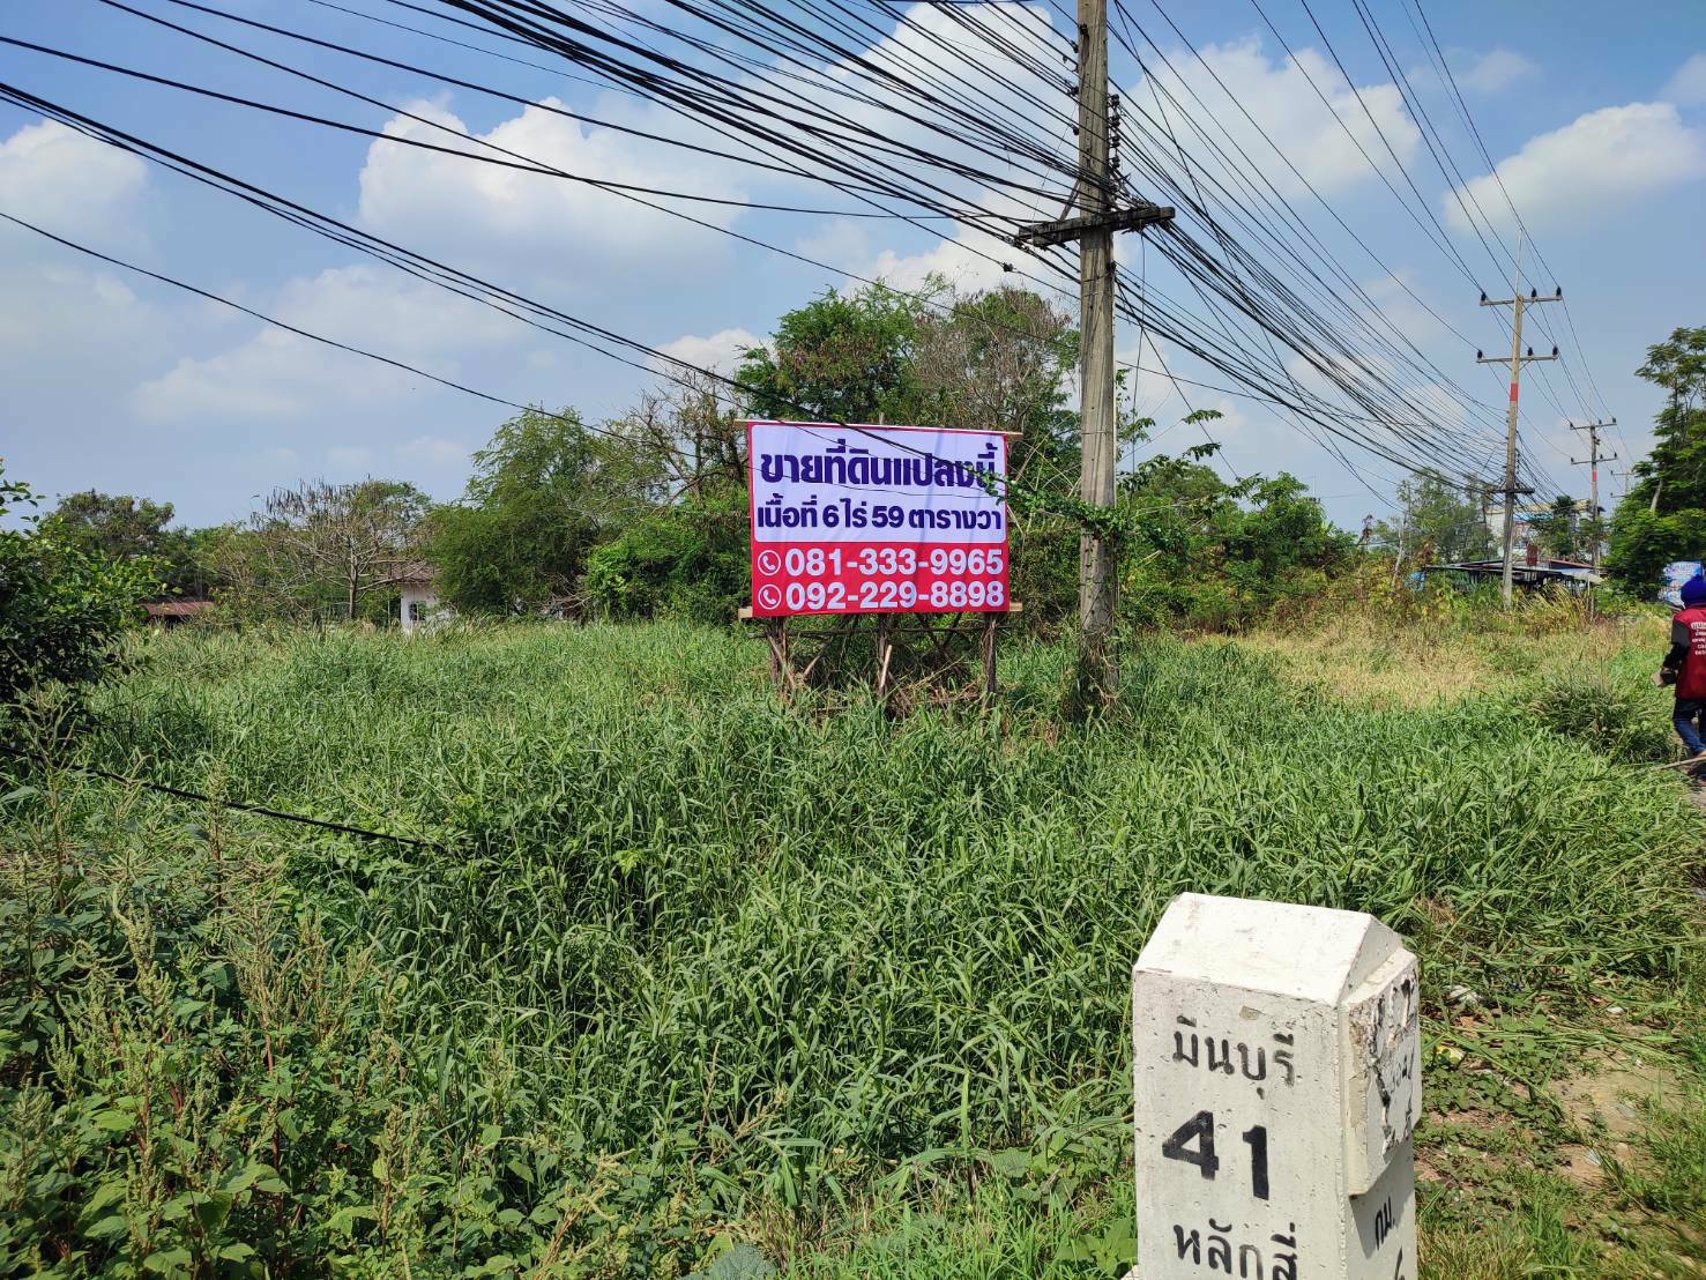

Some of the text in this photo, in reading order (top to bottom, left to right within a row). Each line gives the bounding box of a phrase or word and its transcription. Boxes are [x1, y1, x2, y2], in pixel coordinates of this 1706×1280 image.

[761, 438, 998, 488] ขายที่ดินแปลงนี้
[757, 493, 818, 528] เนื้อที่
[872, 505, 905, 528] 59
[908, 508, 1001, 530] ตารางวา
[785, 548, 1004, 577] 081-333-9965
[785, 580, 1005, 611] 092-229-8898
[1162, 1109, 1270, 1201] 41
